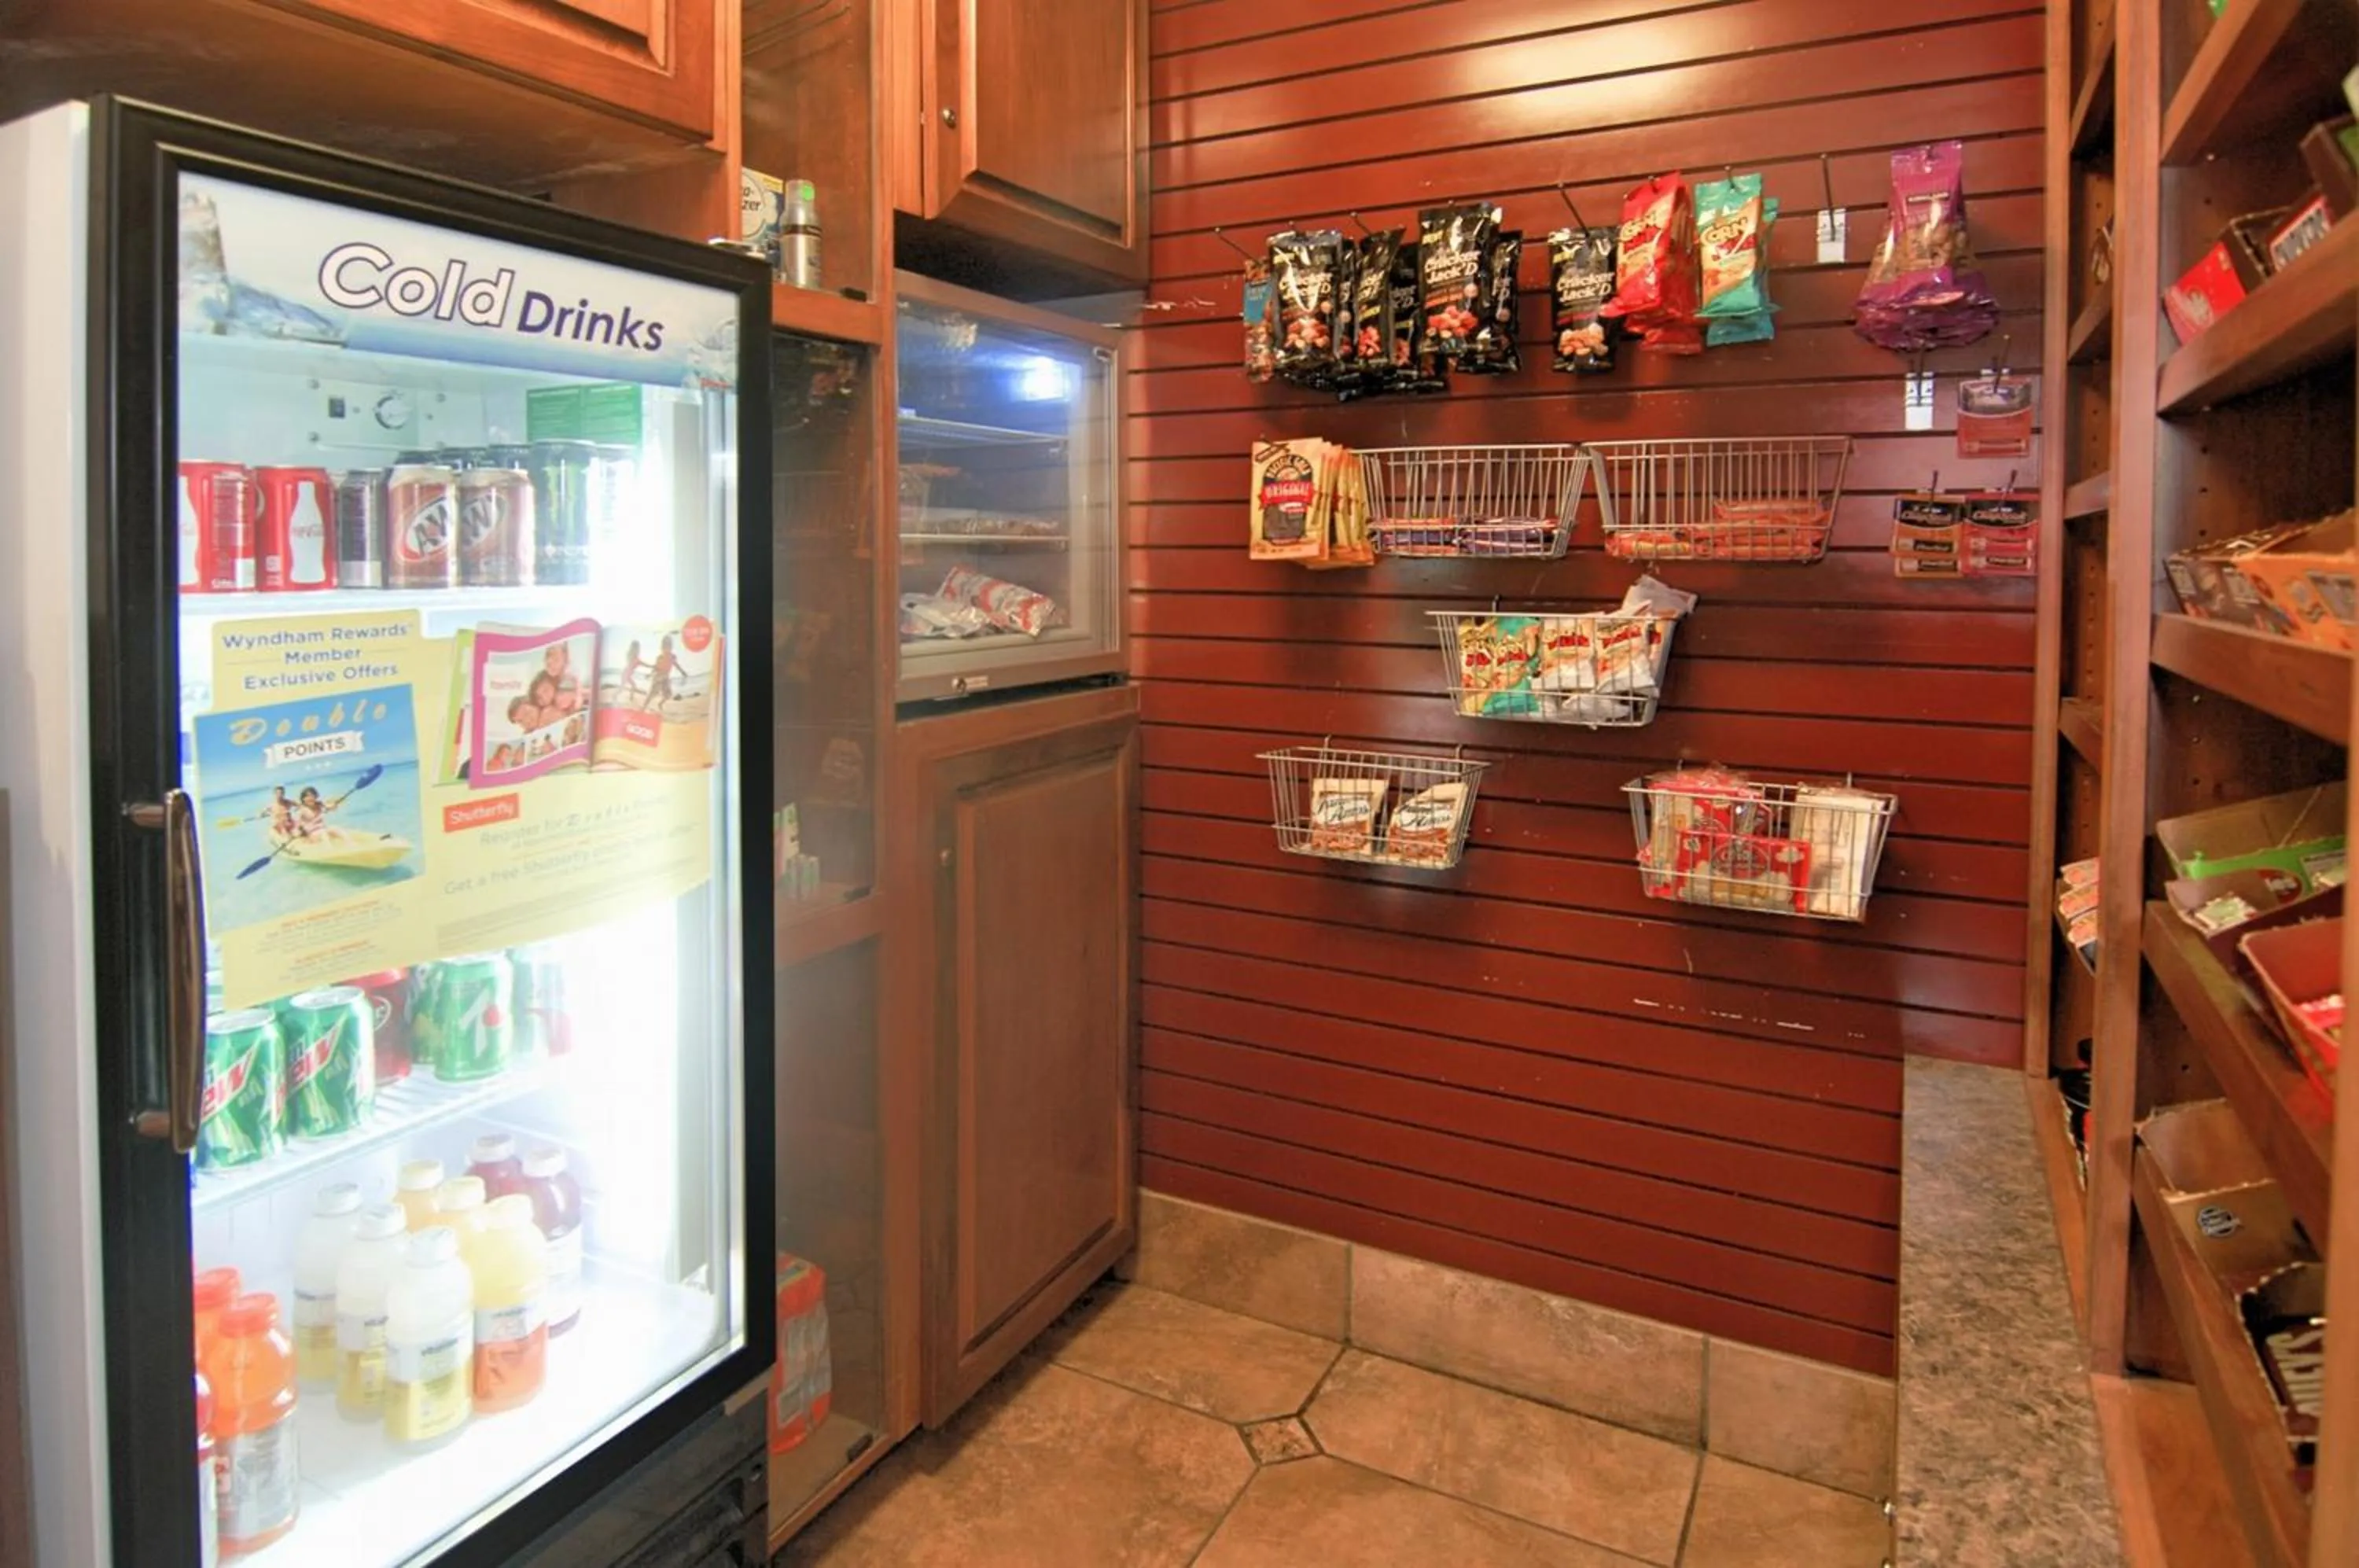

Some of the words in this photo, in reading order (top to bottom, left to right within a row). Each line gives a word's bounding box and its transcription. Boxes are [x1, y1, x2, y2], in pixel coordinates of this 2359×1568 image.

[318, 242, 515, 329] Cold
[517, 291, 664, 352] Drinks
[223, 630, 325, 650] Wyndham
[331, 623, 409, 641] Rewards
[285, 647, 362, 665] Member
[244, 671, 337, 690] Exclusive
[342, 664, 399, 680] Offers
[283, 737, 346, 759] POINTS
[450, 800, 514, 823] Shutterfly
[444, 880, 473, 895] Get
[491, 867, 519, 882] free
